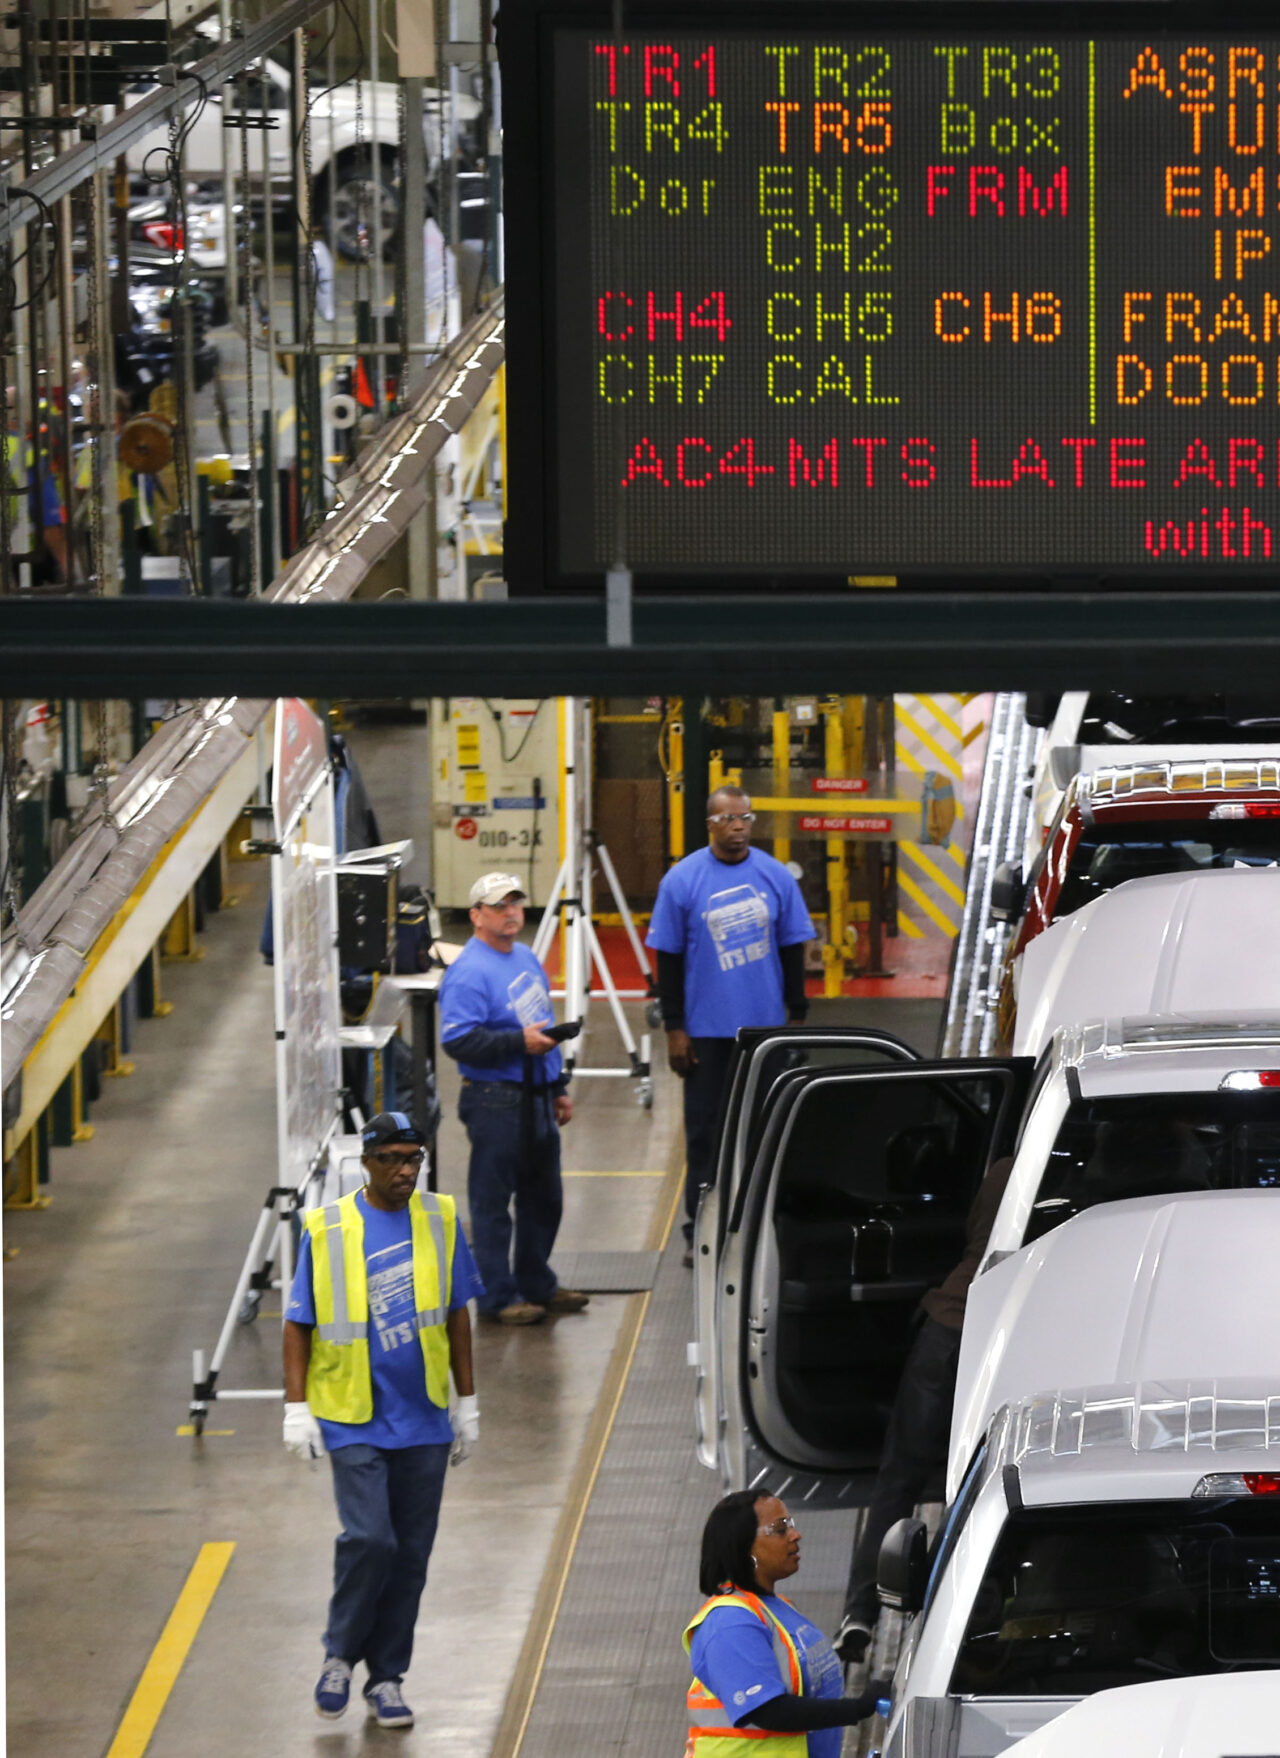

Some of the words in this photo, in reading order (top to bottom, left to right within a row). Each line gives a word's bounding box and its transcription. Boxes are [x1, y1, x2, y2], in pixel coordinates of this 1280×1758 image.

[594, 44, 716, 98] TR1
[765, 46, 891, 98] TR2
[933, 46, 1060, 98] TR3
[595, 101, 729, 153] TR4
[764, 101, 893, 155] TR5
[941, 103, 1060, 154] Box
[611, 165, 715, 216] Dor
[759, 165, 899, 216] ENG
[926, 165, 1069, 218] FRM
[766, 222, 892, 273] CH2
[597, 290, 733, 343] CH4
[767, 291, 893, 342] CH5
[934, 291, 1062, 344] CH6
[599, 354, 725, 404] CH7
[767, 354, 900, 405] CAL
[620, 436, 937, 489] AC4-MTS
[970, 437, 1147, 489] LATE
[1144, 506, 1273, 558] with
[816, 779, 863, 789] DANGER
[803, 818, 820, 828] DO
[823, 819, 847, 829] NOT
[849, 819, 887, 829] ENTER
[377, 1322, 415, 1353] IT'S
